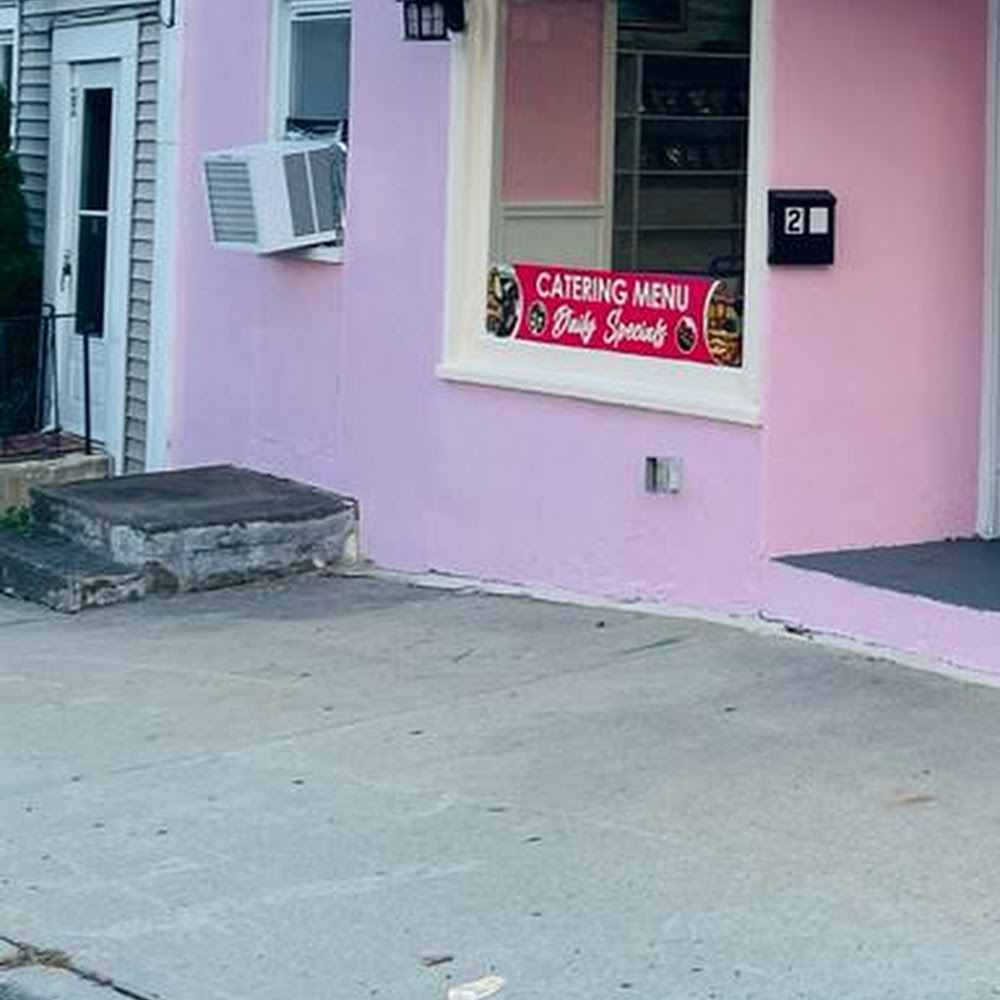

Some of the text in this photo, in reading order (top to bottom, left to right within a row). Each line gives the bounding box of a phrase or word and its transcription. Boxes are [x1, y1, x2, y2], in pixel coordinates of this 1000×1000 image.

[536, 273, 689, 312] CATERING MENU
[552, 304, 668, 348] Daily Specials
